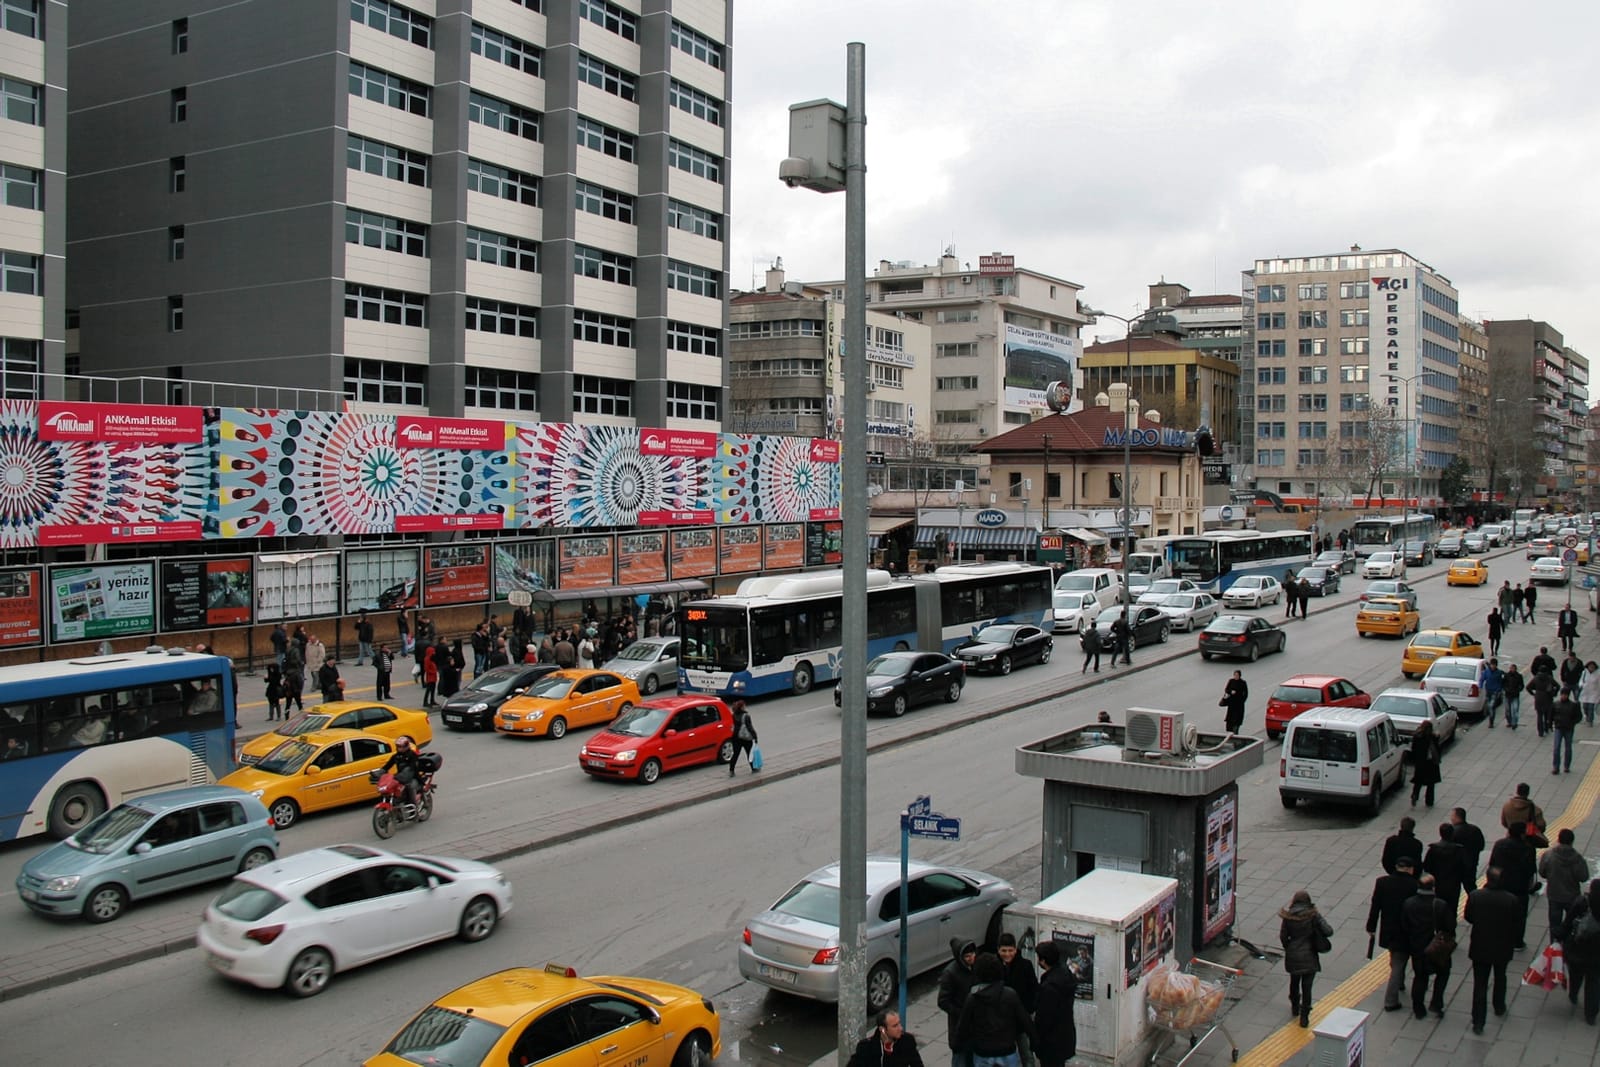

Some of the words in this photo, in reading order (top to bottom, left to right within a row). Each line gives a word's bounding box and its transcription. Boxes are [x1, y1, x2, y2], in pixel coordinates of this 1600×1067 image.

[1377, 278, 1409, 291] AÇI
[56, 419, 94, 433] ANKAmall
[104, 414, 149, 425] ANKAmall
[151, 416, 177, 426] Etkisi!
[439, 426, 469, 435] ANKAmall
[1103, 426, 1159, 446] MADO
[979, 513, 1003, 524] MADO
[107, 575, 150, 591] yeriniz
[118, 590, 149, 601] hazır
[1161, 718, 1172, 749] VESTEL
